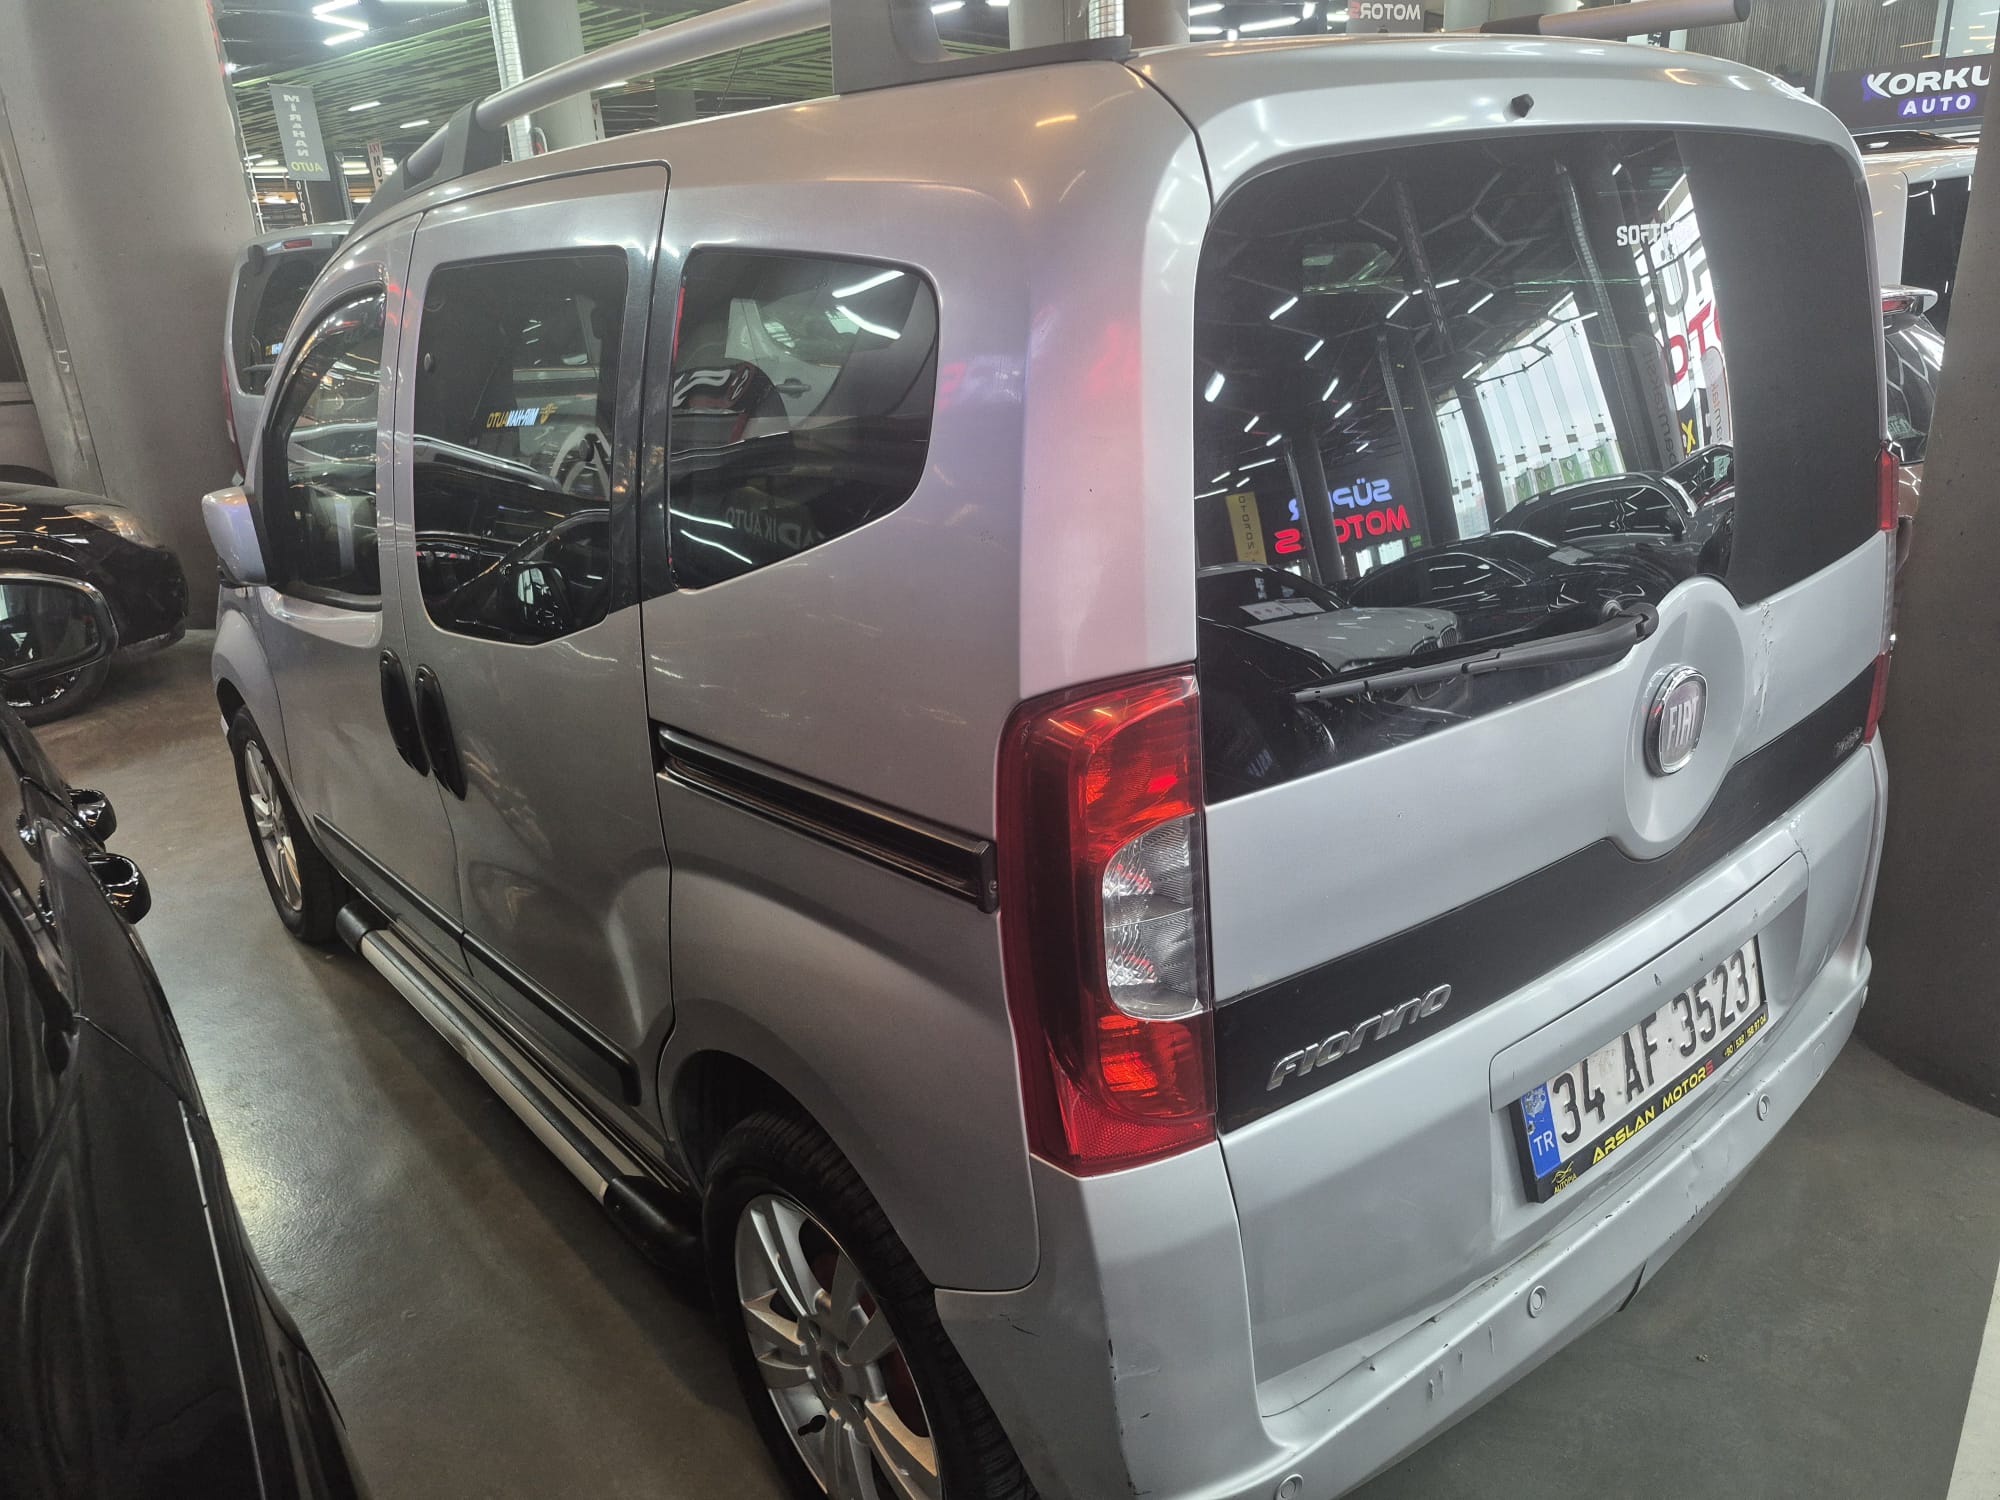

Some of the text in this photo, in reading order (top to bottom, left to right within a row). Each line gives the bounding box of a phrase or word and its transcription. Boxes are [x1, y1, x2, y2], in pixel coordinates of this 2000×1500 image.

[1902, 94, 1971, 116] AUTO
[1666, 695, 1700, 751] FIAT
[1552, 948, 1750, 1145] 34 AF 3523
[1592, 1059, 1714, 1165] ARSLAN MOTORS
[1533, 1129, 1556, 1157] TR
